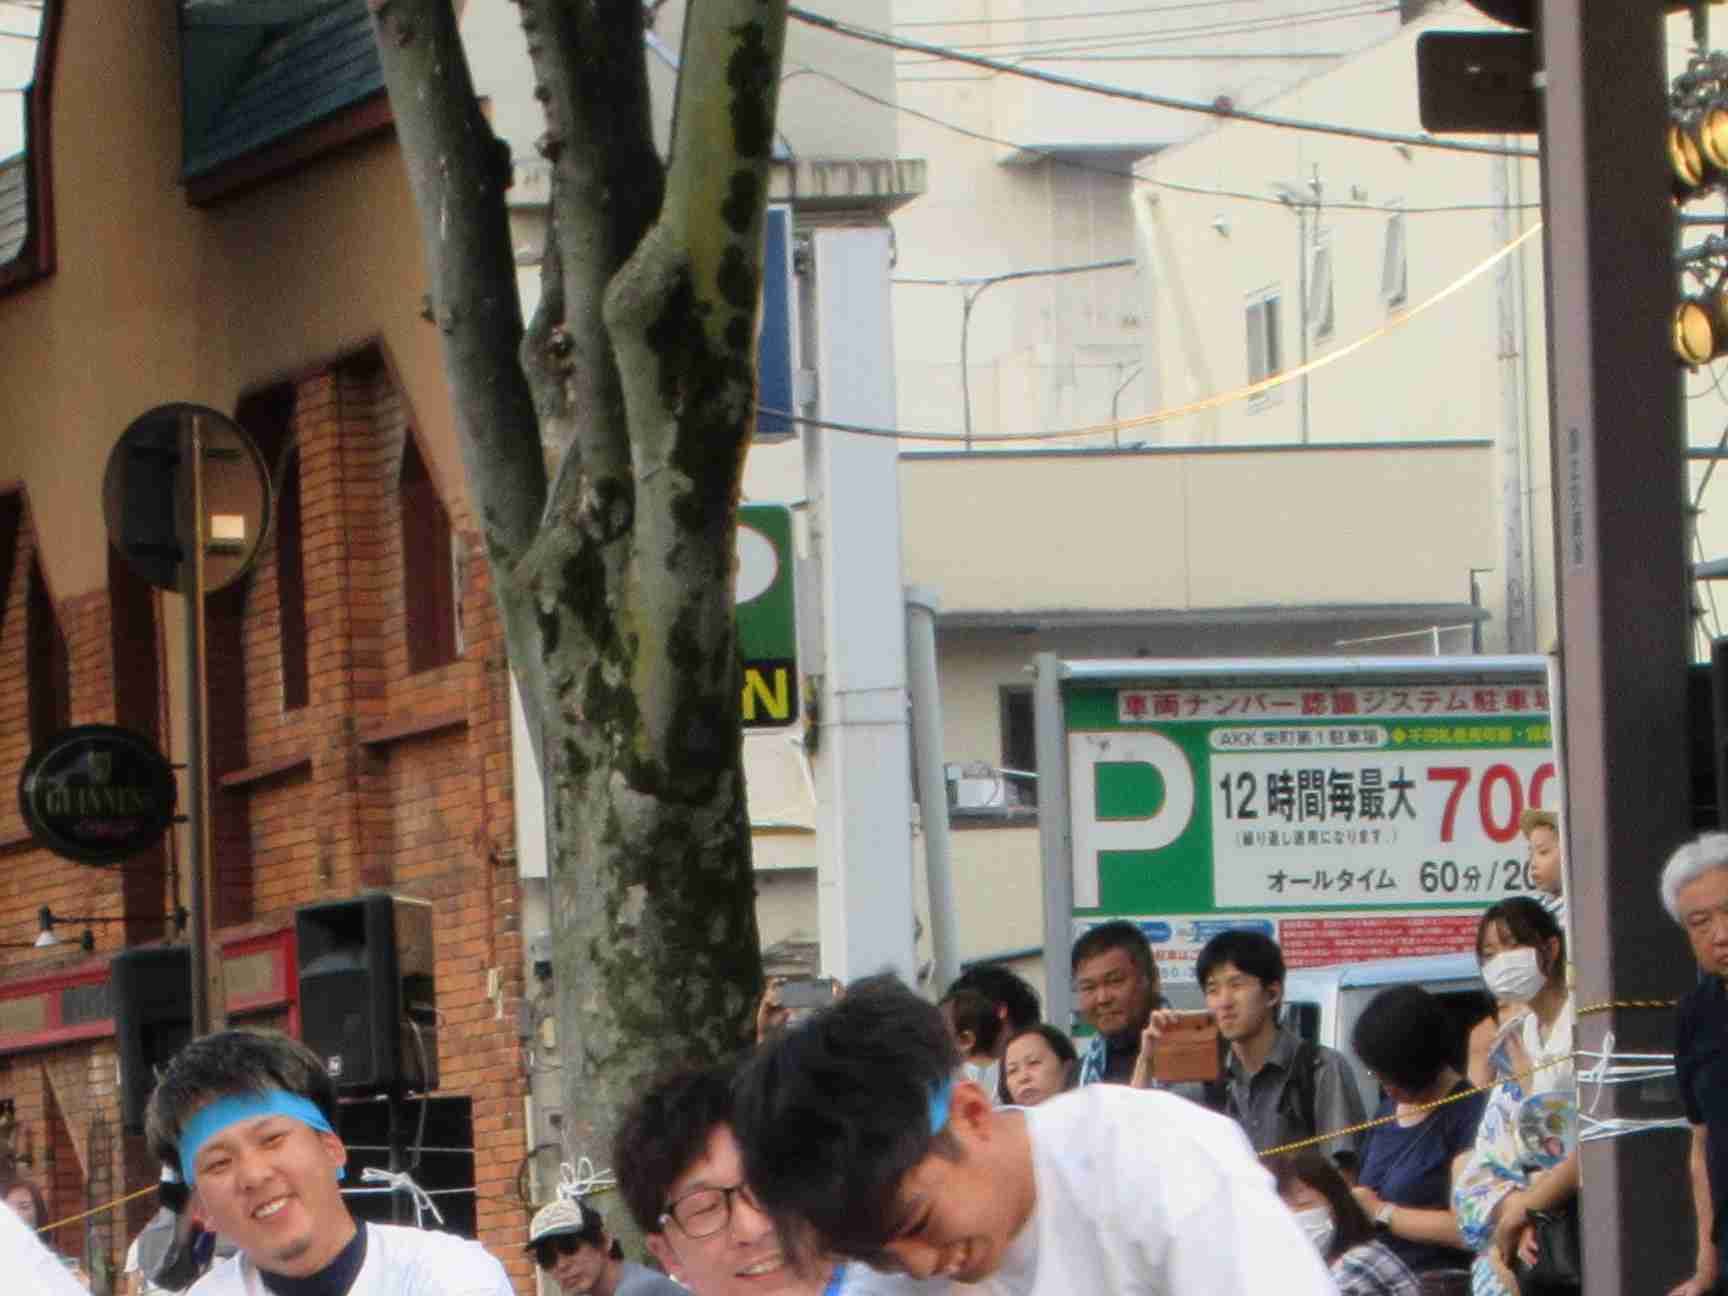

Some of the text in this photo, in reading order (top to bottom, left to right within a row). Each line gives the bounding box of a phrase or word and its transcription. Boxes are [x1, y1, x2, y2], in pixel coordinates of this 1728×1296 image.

[1069, 731, 1195, 909] P
[1267, 868, 1398, 894] オールタイム
